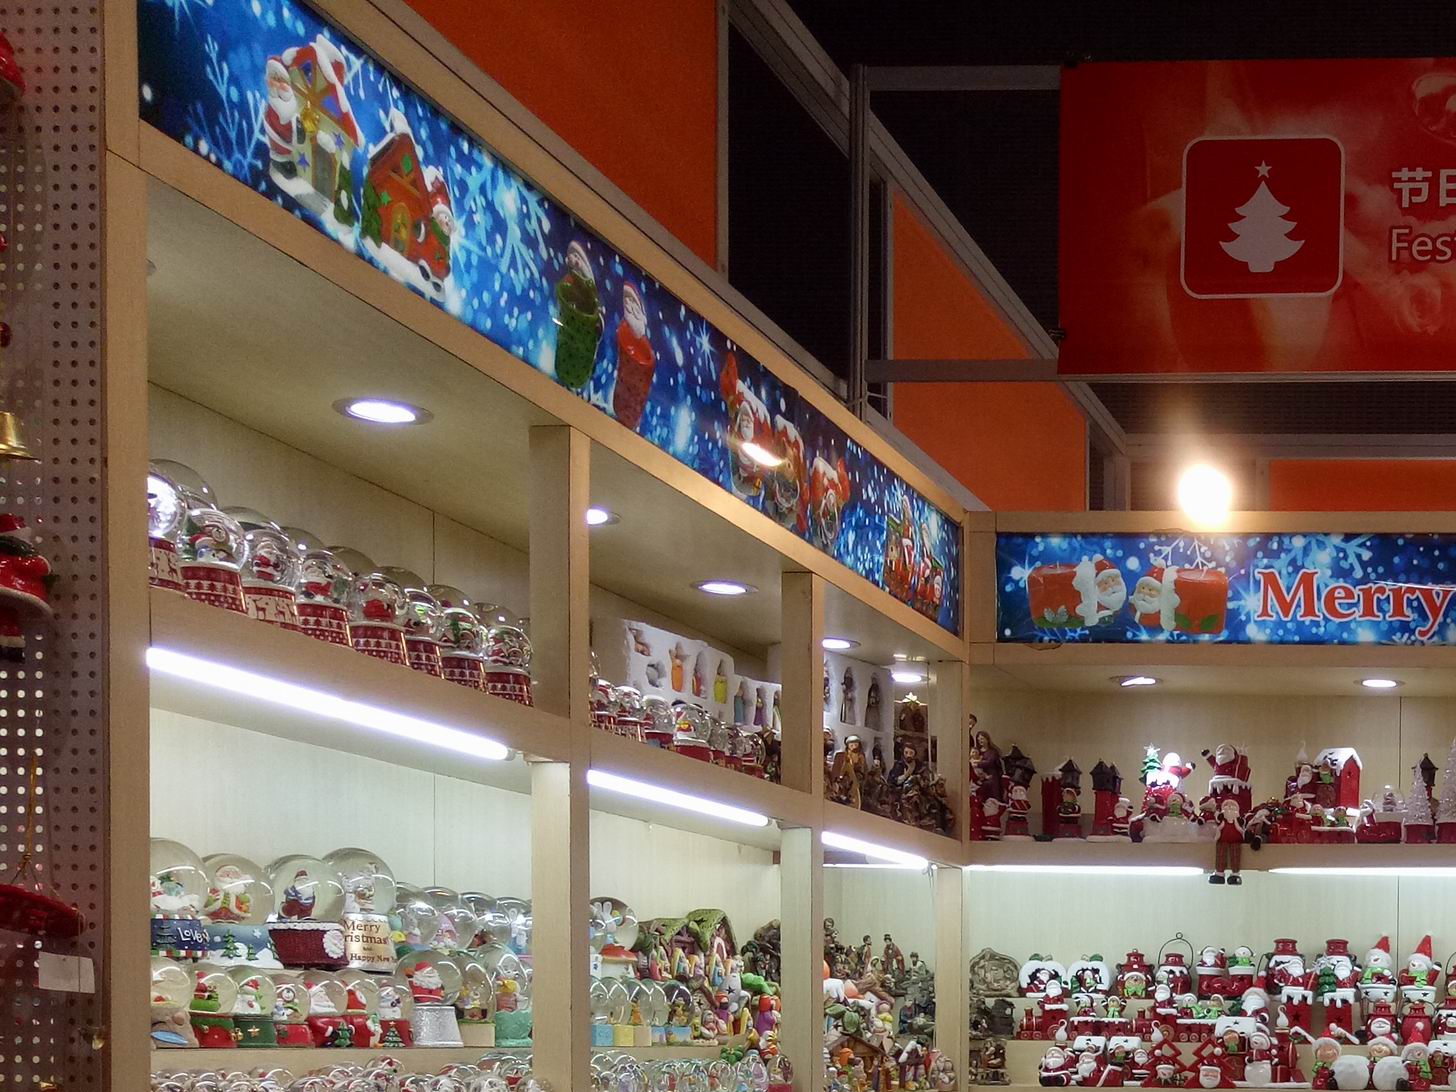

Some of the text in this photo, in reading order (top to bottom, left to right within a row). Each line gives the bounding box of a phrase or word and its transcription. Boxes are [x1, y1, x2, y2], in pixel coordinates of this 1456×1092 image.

[1256, 568, 1456, 639] Merry
[343, 919, 381, 933] Merry
[344, 932, 389, 945] ristmas
[350, 953, 375, 963] Happy
